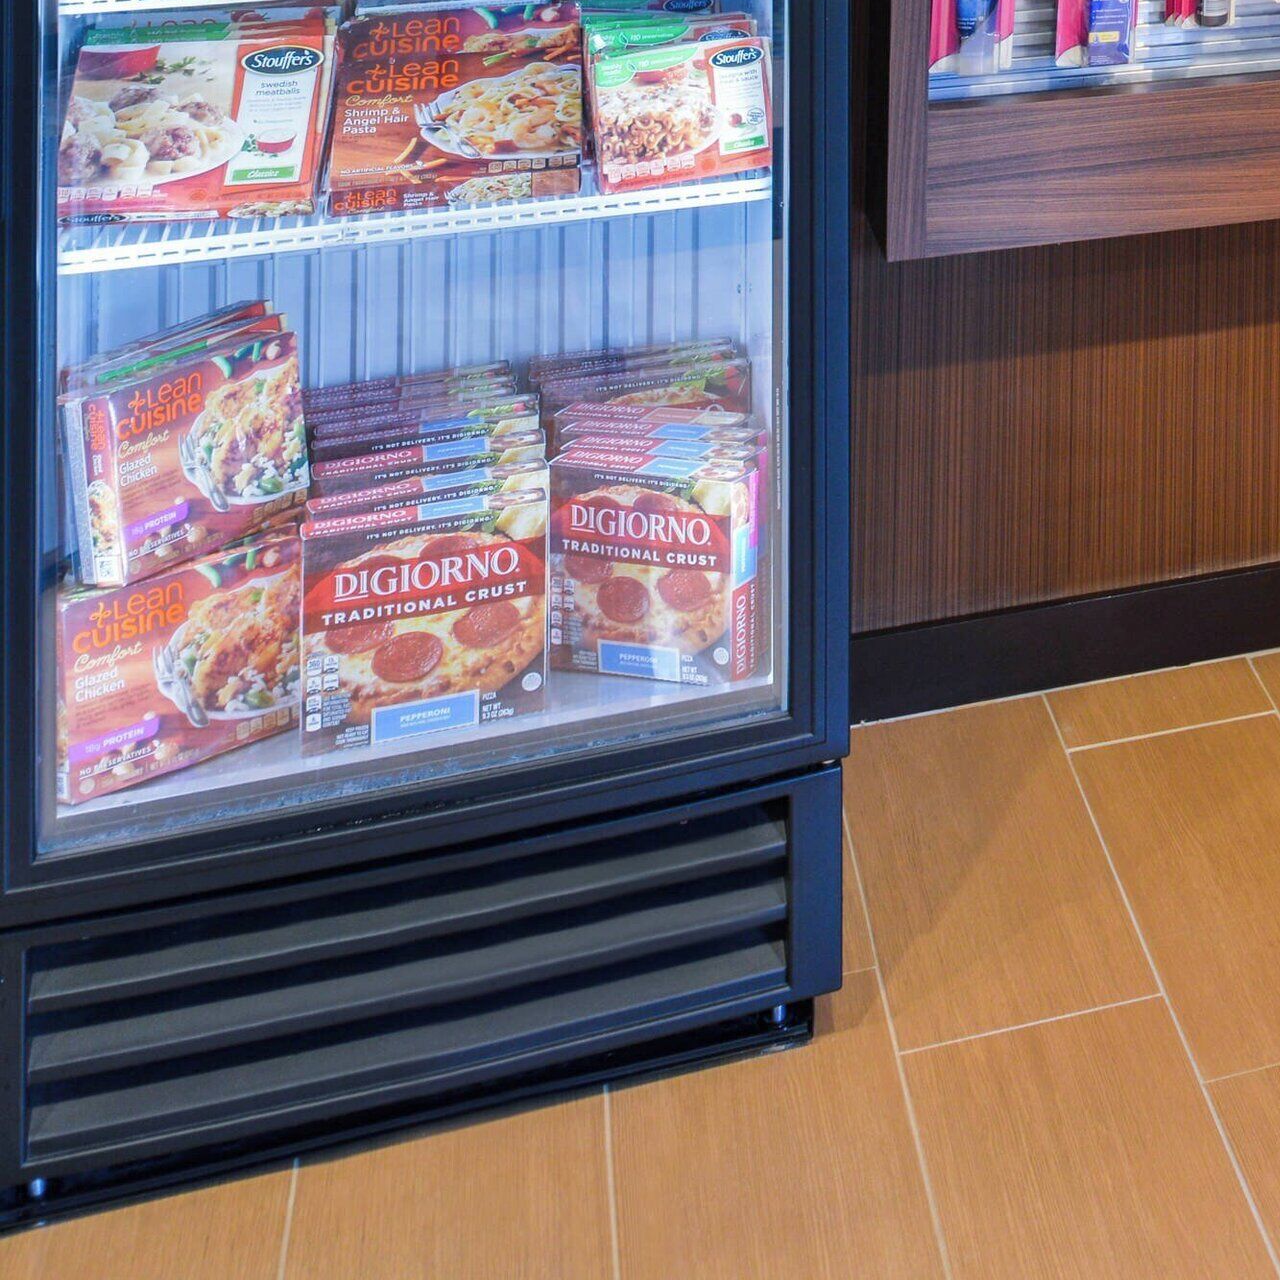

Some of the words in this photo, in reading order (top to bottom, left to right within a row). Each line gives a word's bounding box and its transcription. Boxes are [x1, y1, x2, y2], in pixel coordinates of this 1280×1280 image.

[251, 50, 313, 69] Stouffer's
[716, 49, 757, 64] Stouffer's
[255, 87, 300, 95] meatballs
[260, 80, 298, 88] swedish
[345, 94, 414, 106] Comfort
[343, 116, 380, 126] Angel
[384, 114, 409, 123] Hair
[344, 108, 388, 118] Shrimp
[343, 125, 376, 134] Pasta
[119, 454, 152, 474] Glazed
[120, 466, 158, 487] Chicken
[571, 504, 711, 545] DIGIORNO
[563, 539, 661, 563] TRADITIONAL
[667, 552, 717, 566] CRUST
[335, 547, 519, 602] DIGIORNO
[322, 596, 457, 626] TRADITIONAL
[465, 581, 527, 602] CRUST
[74, 641, 143, 673] Comfort
[75, 667, 118, 690] Glazed
[75, 680, 125, 703] Chicken
[401, 707, 450, 722] PEPPERONI
